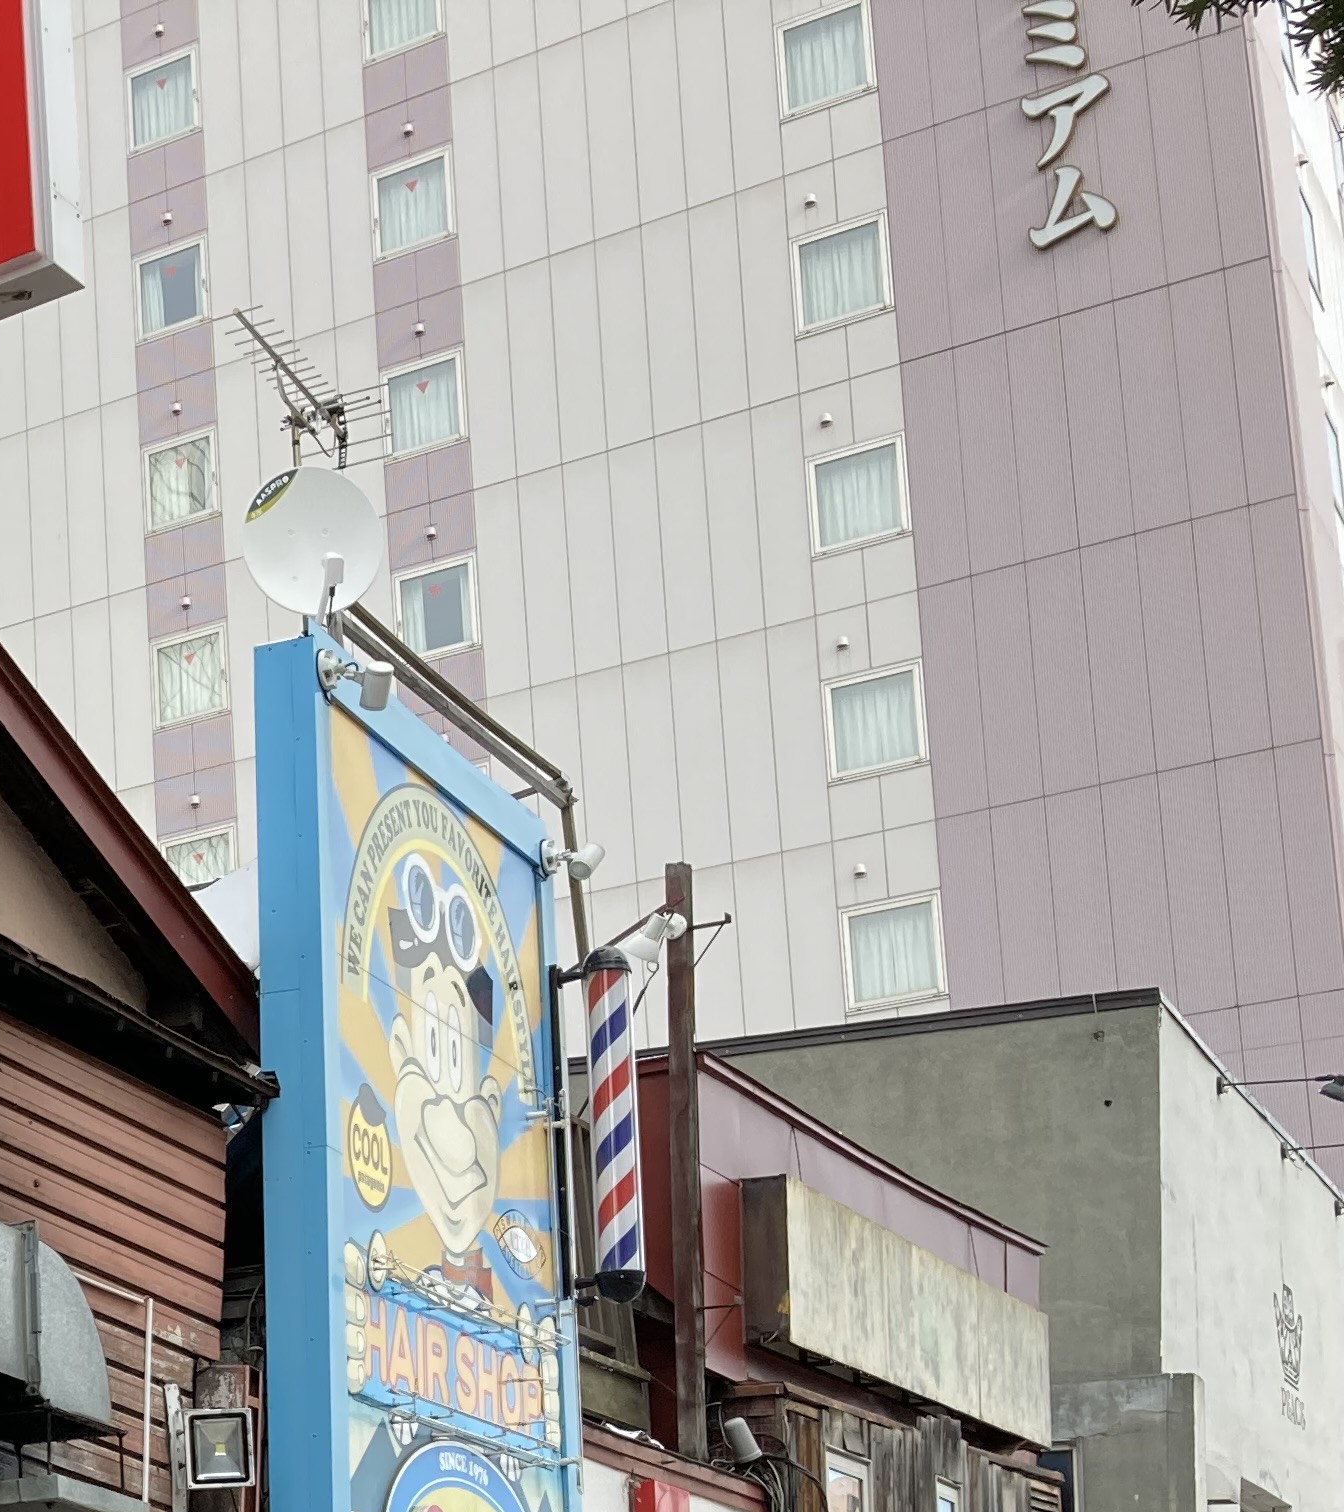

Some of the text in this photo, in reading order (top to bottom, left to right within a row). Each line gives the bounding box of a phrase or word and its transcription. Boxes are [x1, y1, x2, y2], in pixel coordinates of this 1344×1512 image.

[365, 799, 413, 873] PRESENT
[412, 799, 439, 834] YOU
[352, 865, 377, 927] CAN
[440, 814, 498, 919] FAVORITE
[347, 925, 363, 976] WE
[494, 921, 519, 994] HAIR
[352, 1123, 388, 1175] COOL
[363, 1290, 544, 1434] HAIR SHOP
[439, 1451, 489, 1487] SINCE 1976
